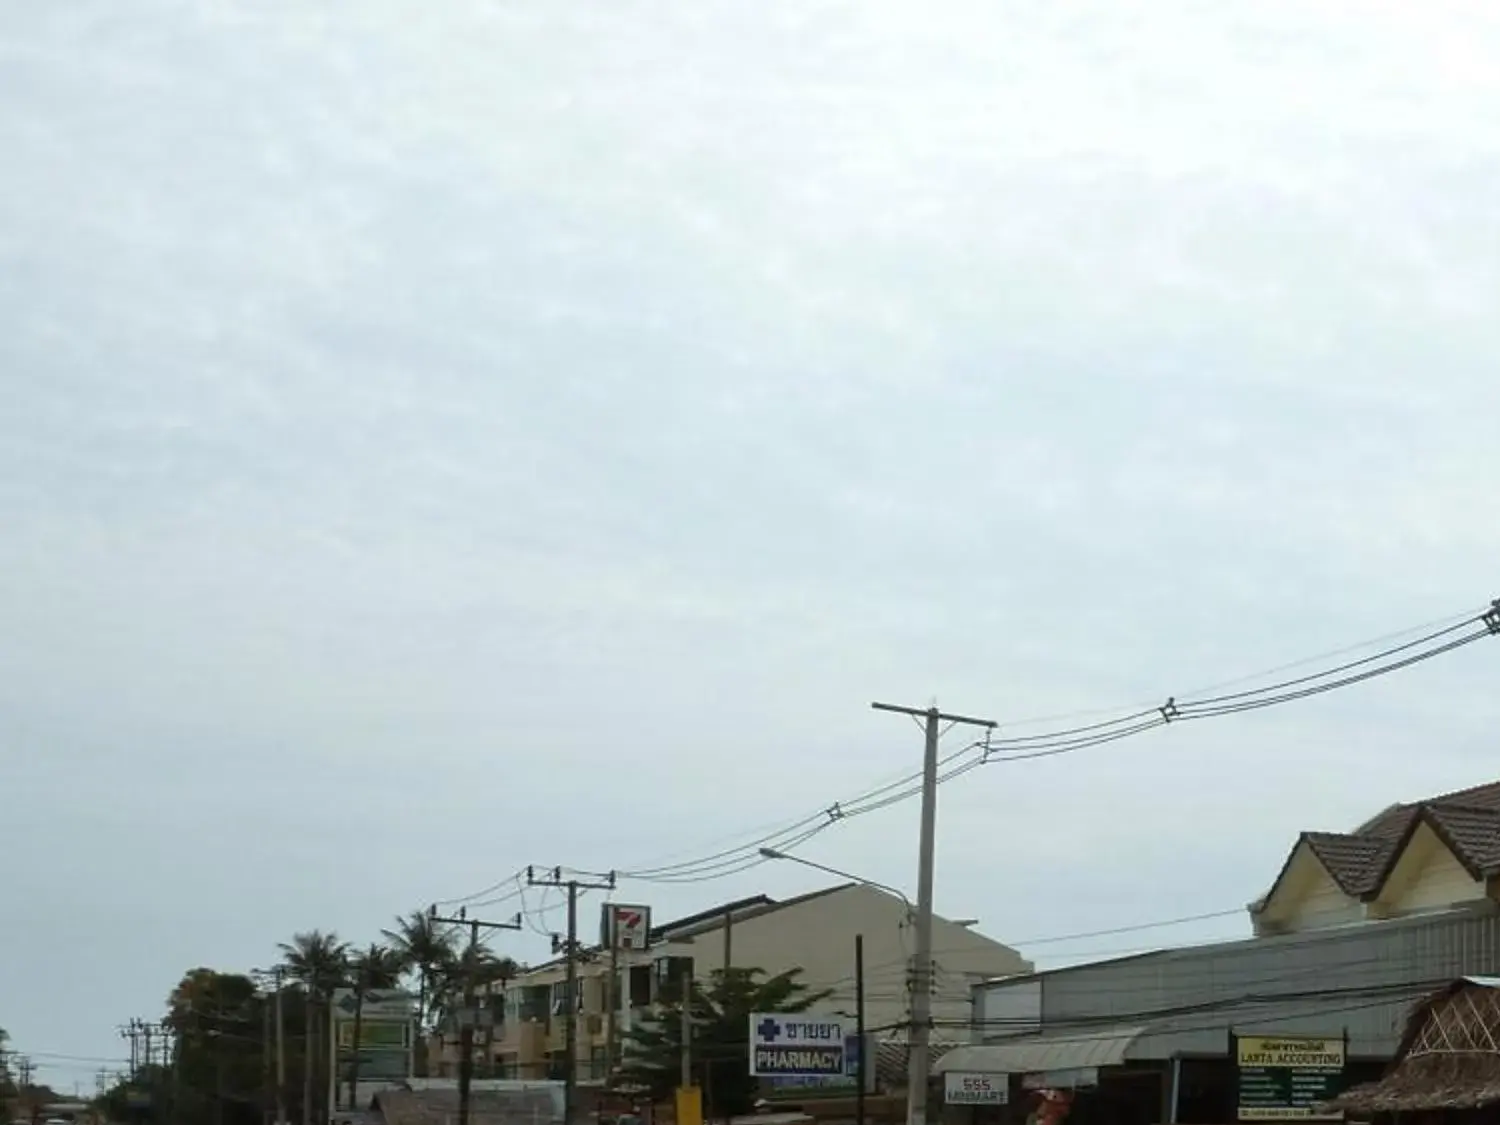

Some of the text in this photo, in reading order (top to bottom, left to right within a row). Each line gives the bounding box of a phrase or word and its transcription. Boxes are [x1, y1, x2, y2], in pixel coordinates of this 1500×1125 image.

[757, 1051, 840, 1069] PHARMACY
[1241, 1053, 1341, 1064] LANTA ACCOUNTING
